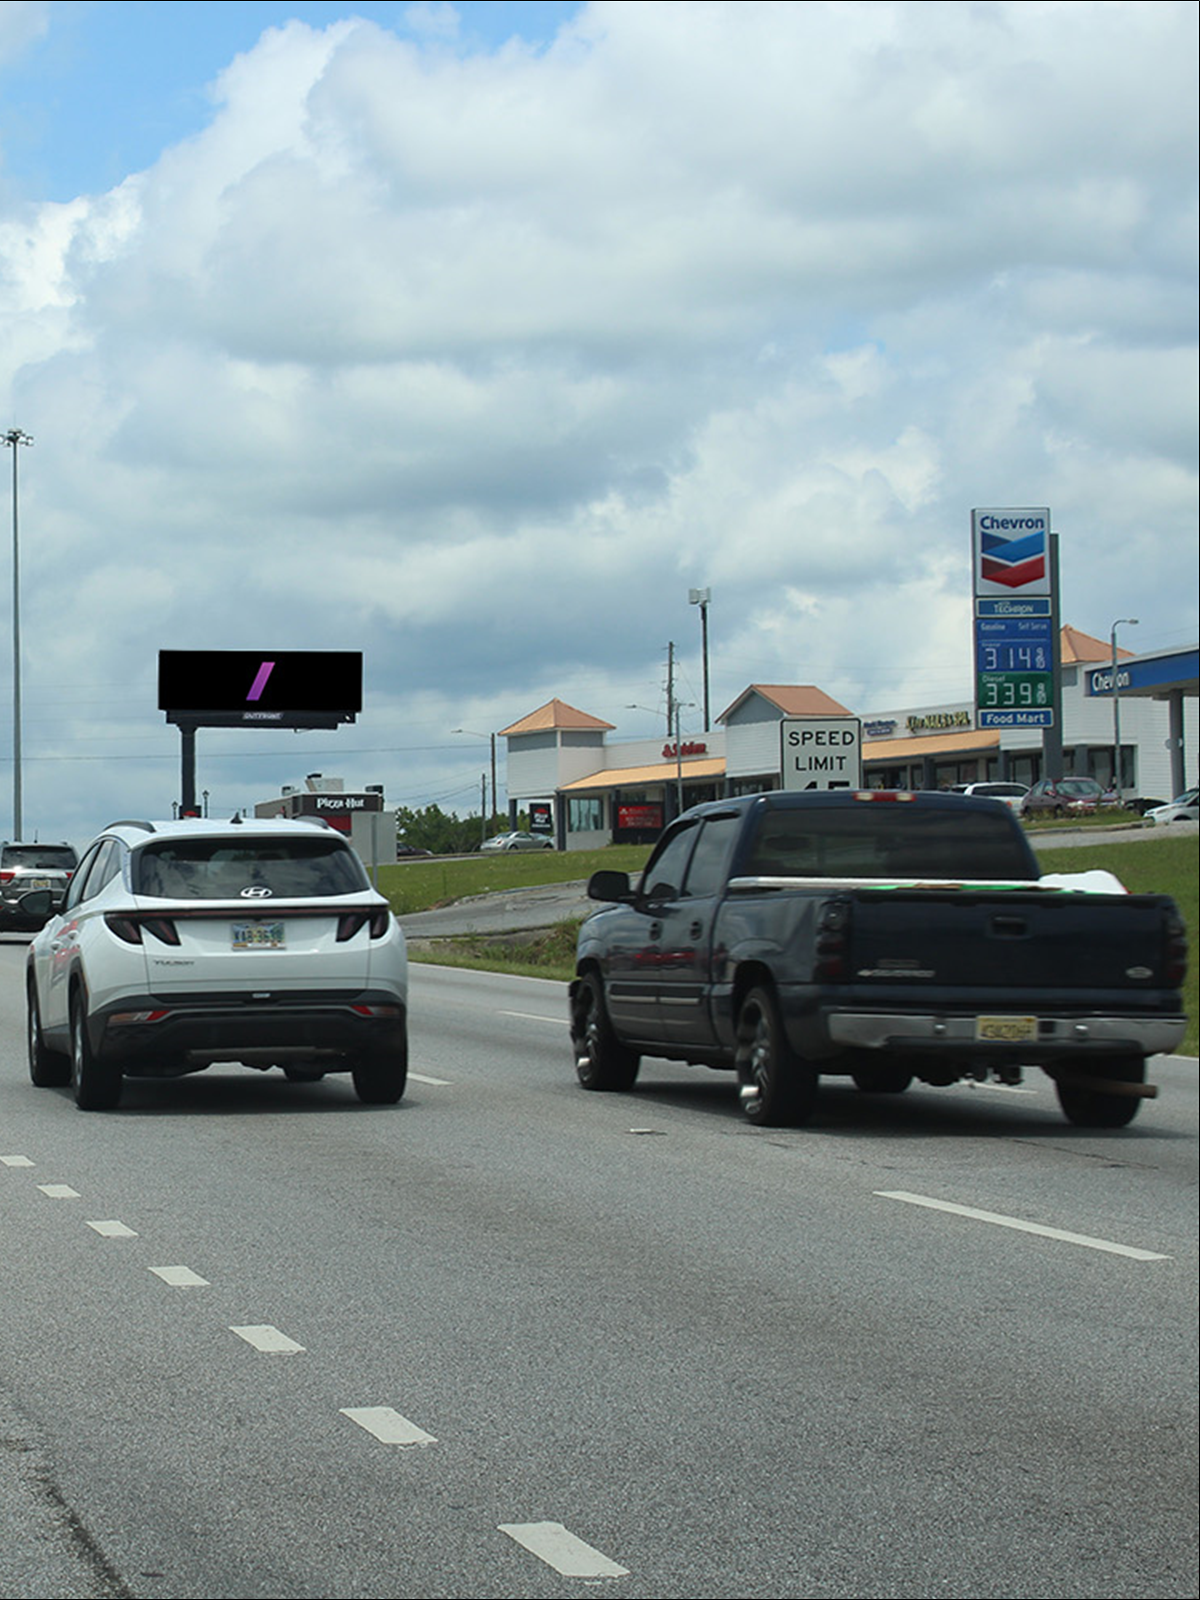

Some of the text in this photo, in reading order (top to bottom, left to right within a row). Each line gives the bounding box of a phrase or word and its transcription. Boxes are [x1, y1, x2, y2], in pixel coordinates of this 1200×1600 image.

[980, 515, 1044, 530] Chevron
[1092, 672, 1130, 691] Chevon
[986, 713, 1045, 724] Food Mart
[788, 731, 855, 746] SPEED
[795, 756, 847, 771] LIMIT
[317, 798, 364, 809] Pizza Hut
